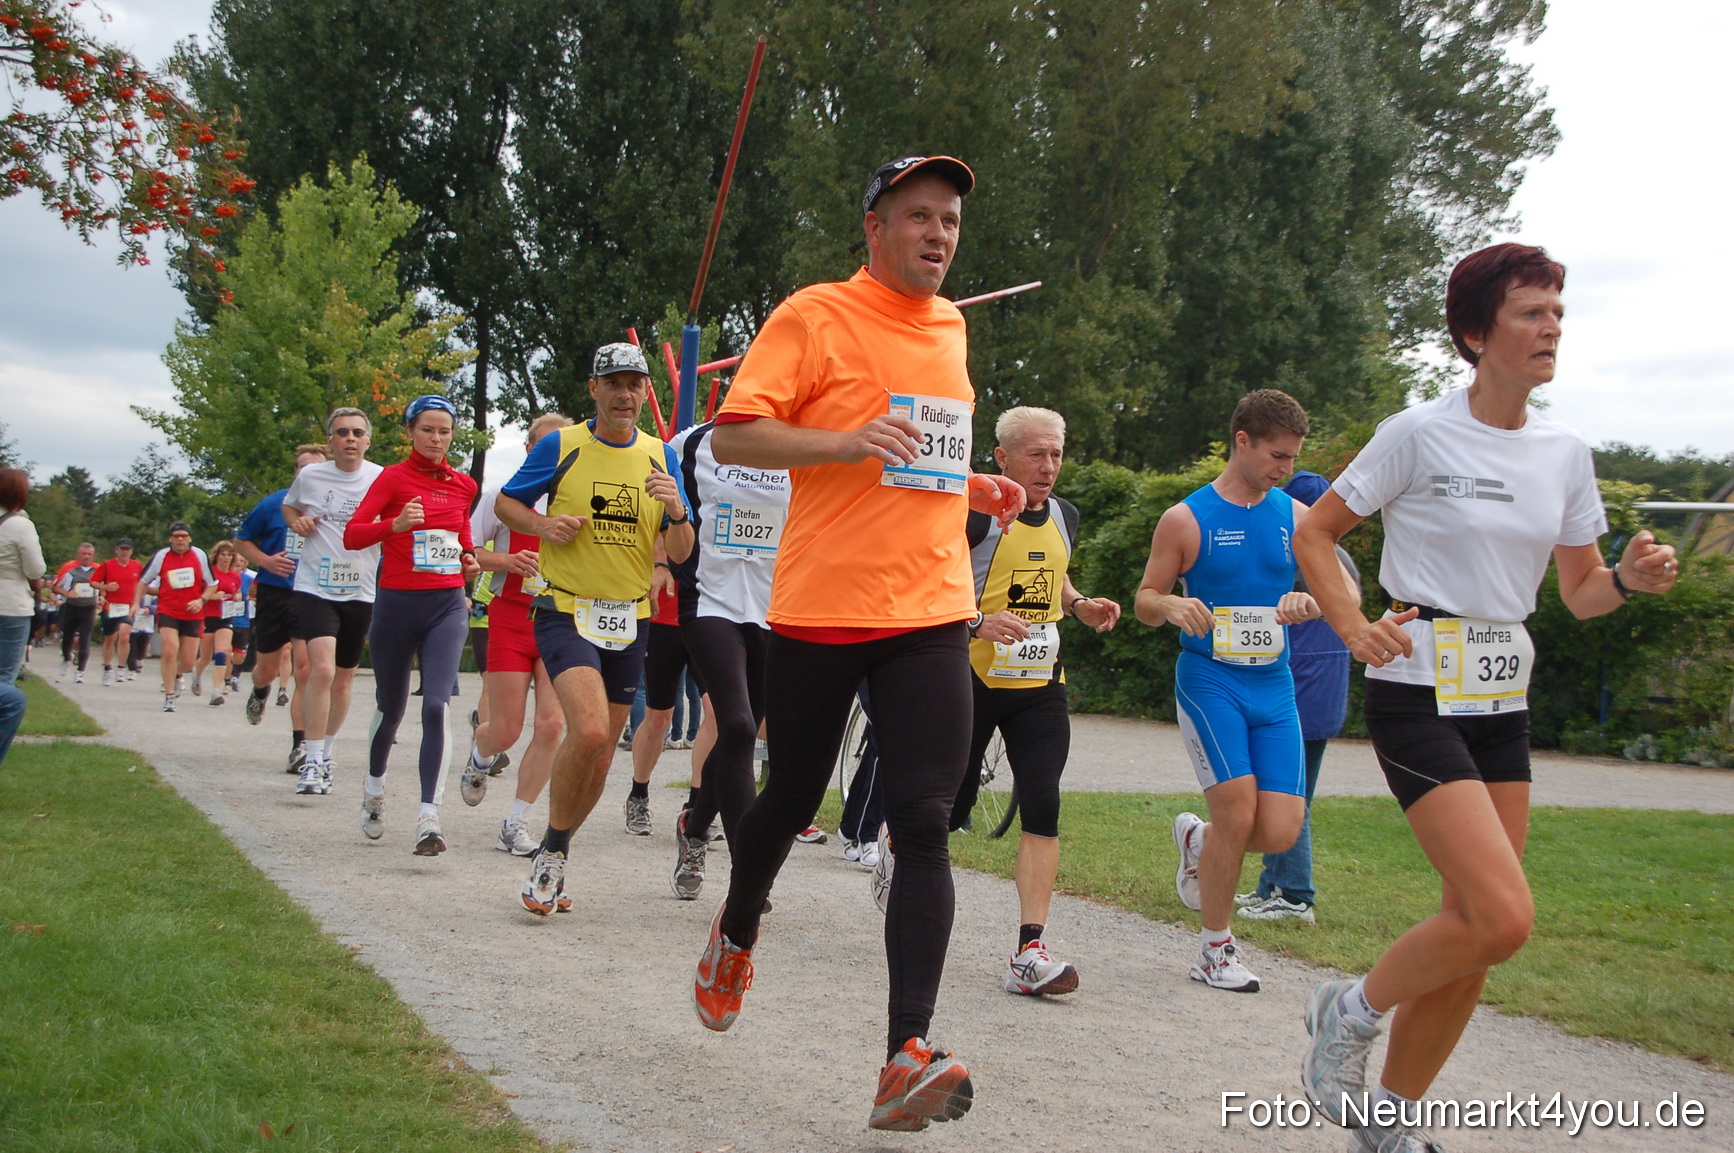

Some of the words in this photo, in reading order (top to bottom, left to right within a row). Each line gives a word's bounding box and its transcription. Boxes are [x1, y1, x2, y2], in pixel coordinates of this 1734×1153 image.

[921, 405, 959, 428] Rüdiger
[920, 433, 965, 461] 3186
[727, 469, 787, 483] Fischer
[734, 482, 785, 491] Automobile
[734, 508, 761, 520] Stefan
[593, 521, 637, 534] HIRSCH
[734, 523, 774, 540] 3027
[431, 547, 458, 559] 2472
[332, 571, 360, 581] 3110
[593, 598, 631, 611] Alexander
[597, 616, 627, 632] 554
[1233, 612, 1263, 623] Stefan
[1240, 630, 1273, 646] 358
[1467, 625, 1511, 644] Andrea
[1018, 644, 1048, 660] 485
[1440, 655, 1448, 669] C
[1477, 655, 1520, 682] 329
[1191, 738, 1208, 770] 2XU
